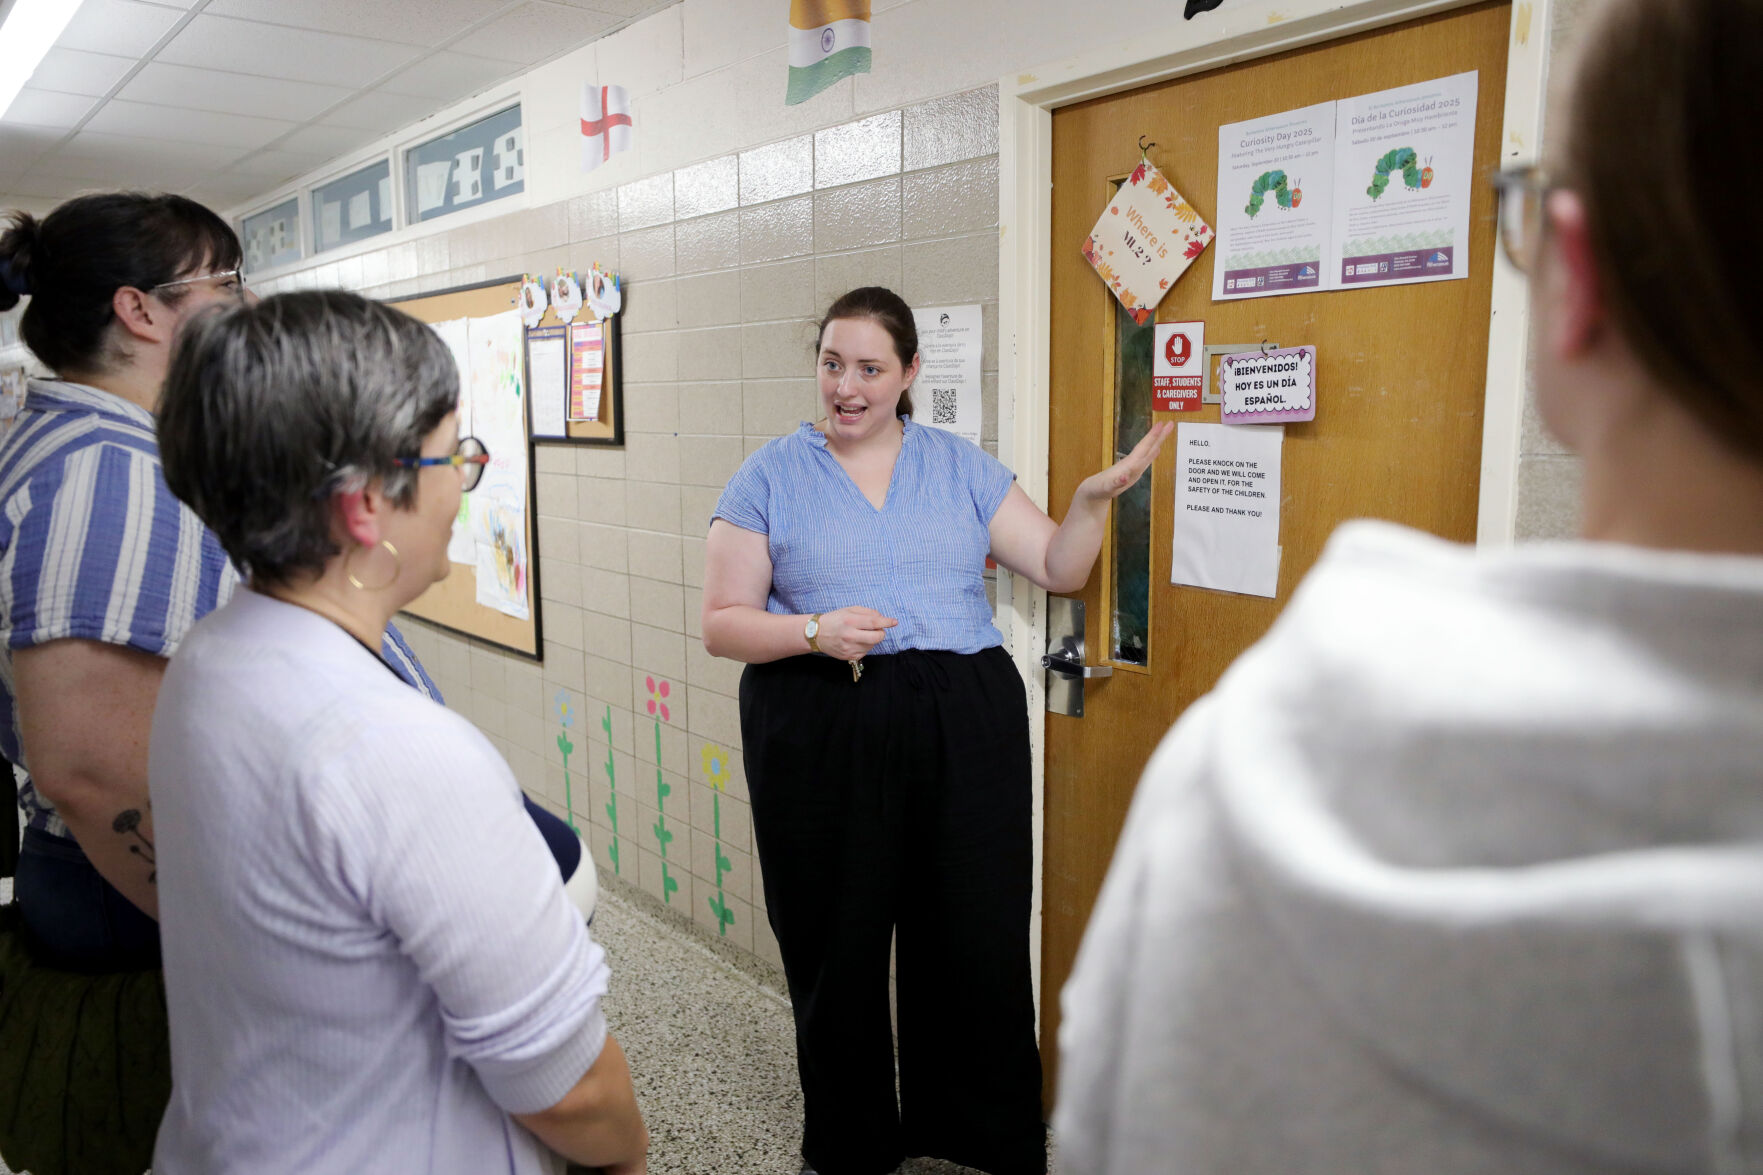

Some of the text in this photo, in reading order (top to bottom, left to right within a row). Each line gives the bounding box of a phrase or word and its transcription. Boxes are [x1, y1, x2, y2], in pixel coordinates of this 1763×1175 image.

[1351, 116, 1365, 125] Día
[1367, 114, 1378, 122] de
[1380, 111, 1386, 120] la
[1388, 101, 1436, 118] Curiosidad
[1438, 98, 1460, 108] 2025
[1240, 135, 1275, 148] Curiosity
[1276, 132, 1292, 142] Day
[1294, 128, 1312, 138] 2025
[1126, 205, 1168, 258] Where is
[1234, 362, 1298, 377] ¡BIENVENIDOS!
[1154, 377, 1202, 388] STAFF, STUDENTS
[1235, 376, 1296, 392] HOY ES UN DÍA
[1156, 389, 1198, 398] & CAREGIVERS
[1244, 393, 1286, 406] ESPAÑOL.
[1169, 400, 1184, 410] ONLY
